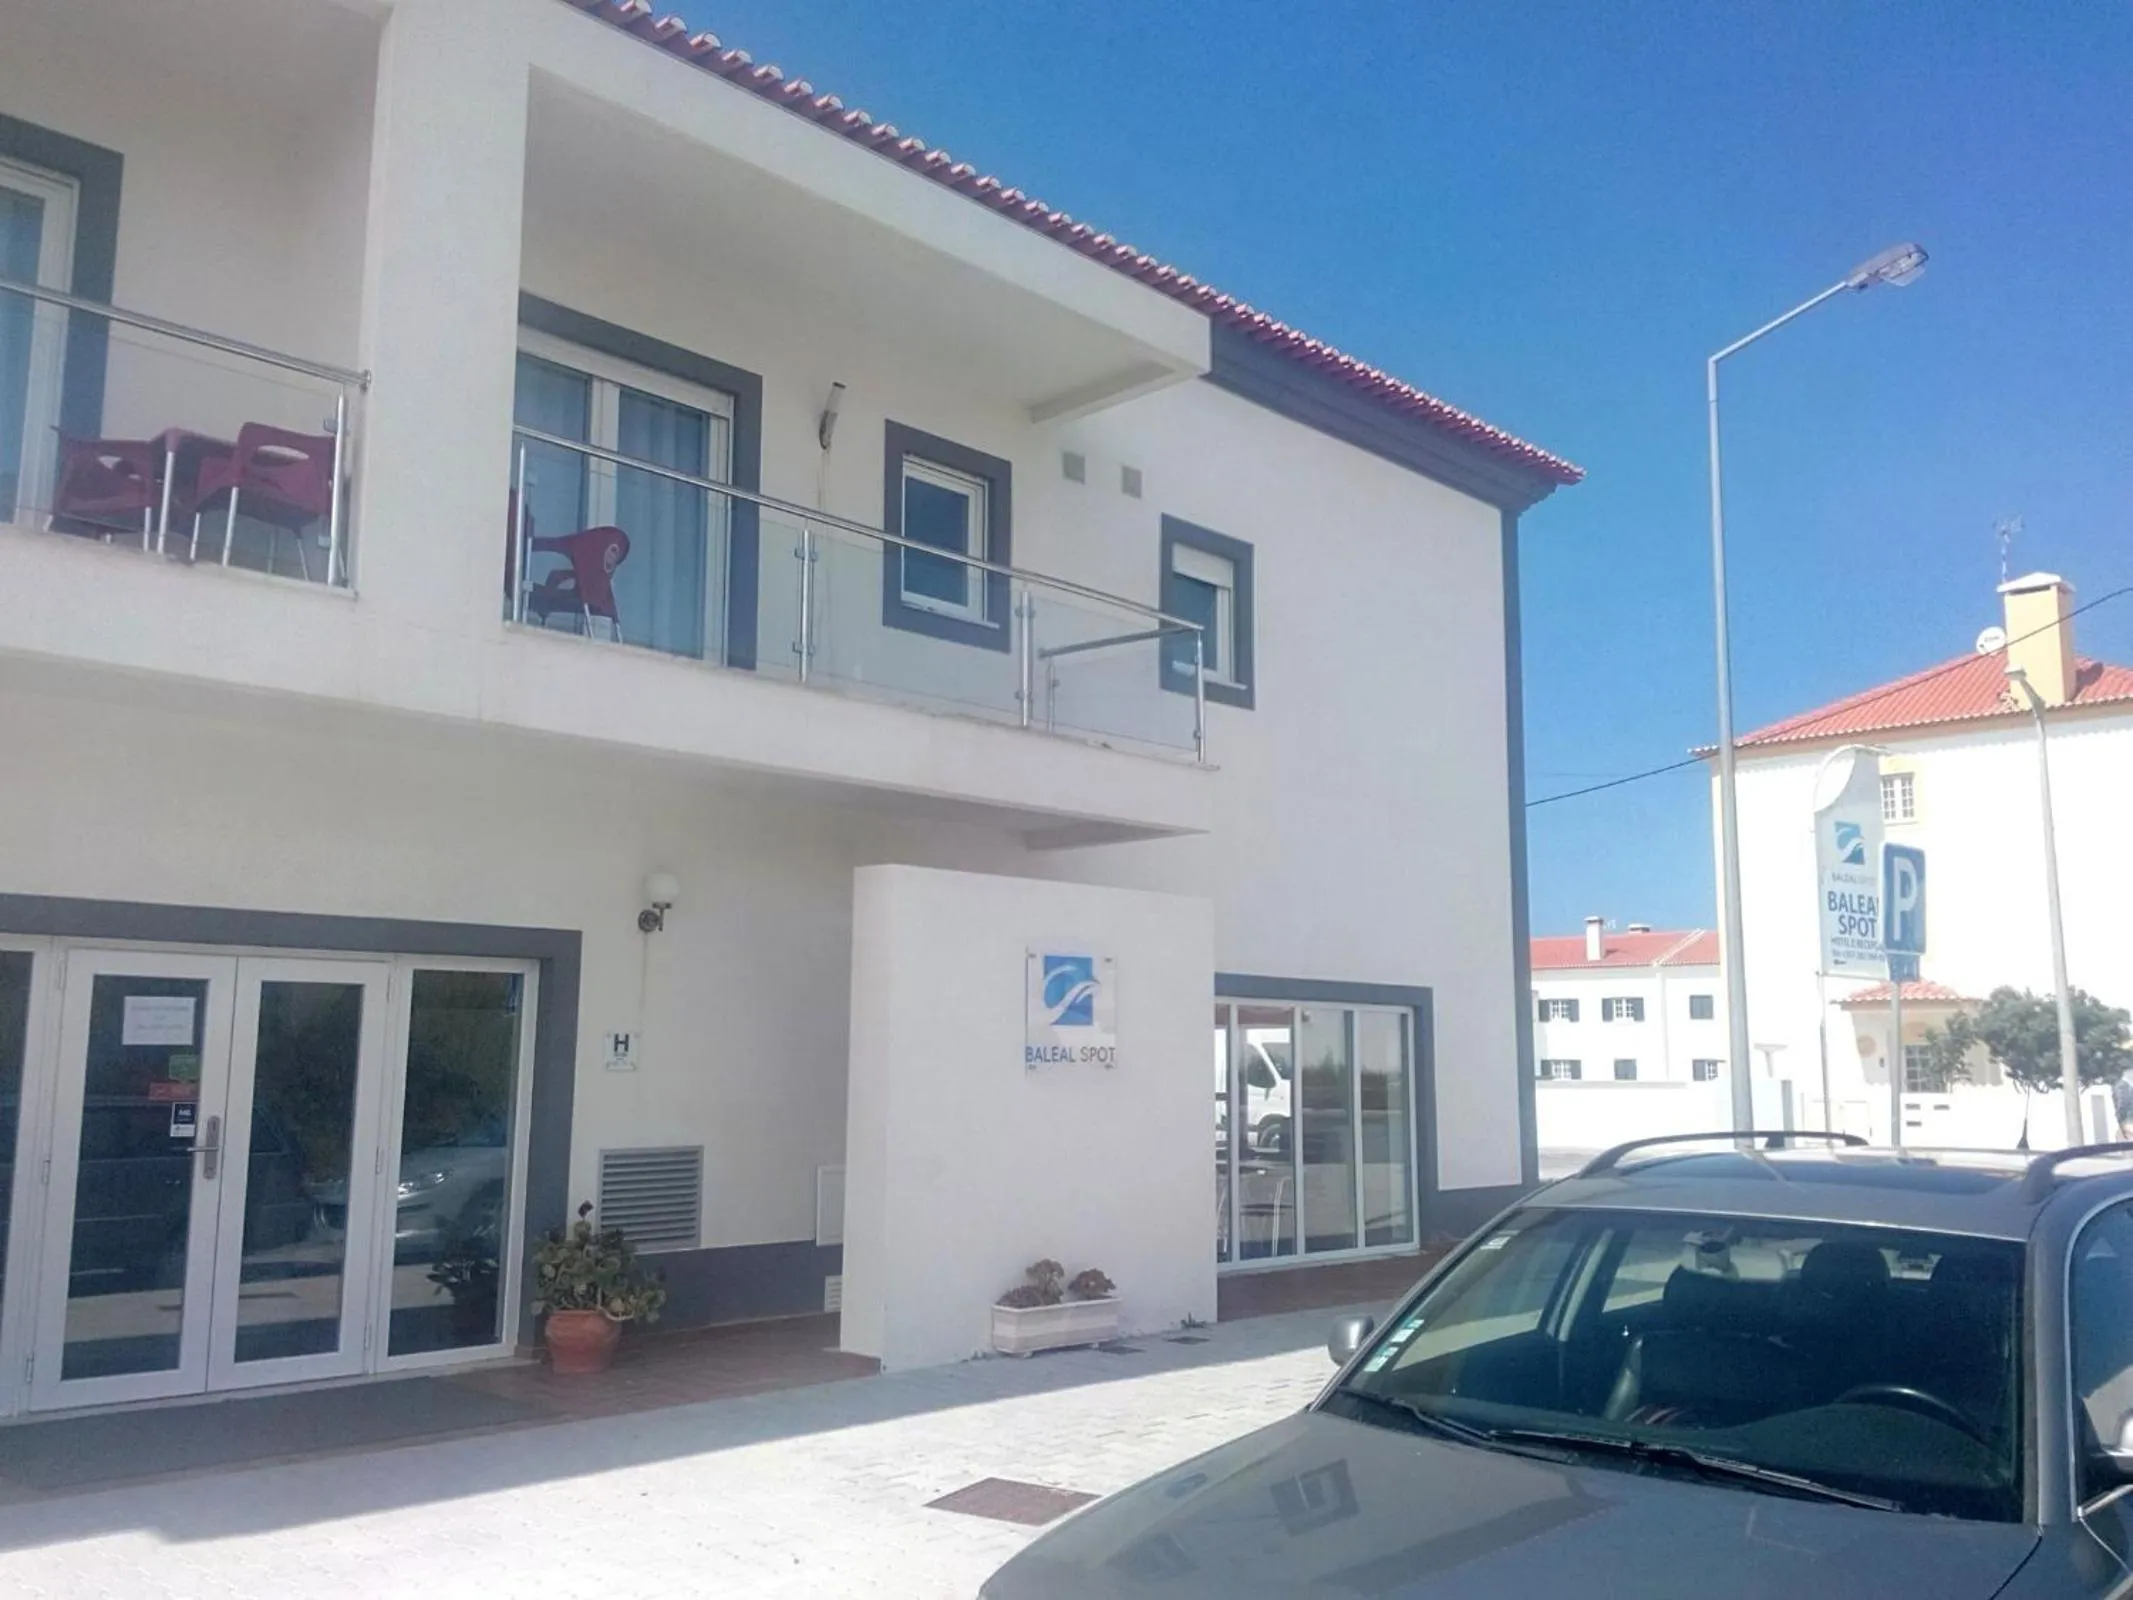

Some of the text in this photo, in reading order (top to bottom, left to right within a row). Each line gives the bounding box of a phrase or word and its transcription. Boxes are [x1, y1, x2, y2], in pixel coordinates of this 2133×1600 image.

[1893, 856, 1918, 942] P
[1838, 914, 1877, 938] SPOT
[614, 1033, 629, 1052] H
[1025, 1046, 1115, 1062] BALEAL SPOT
